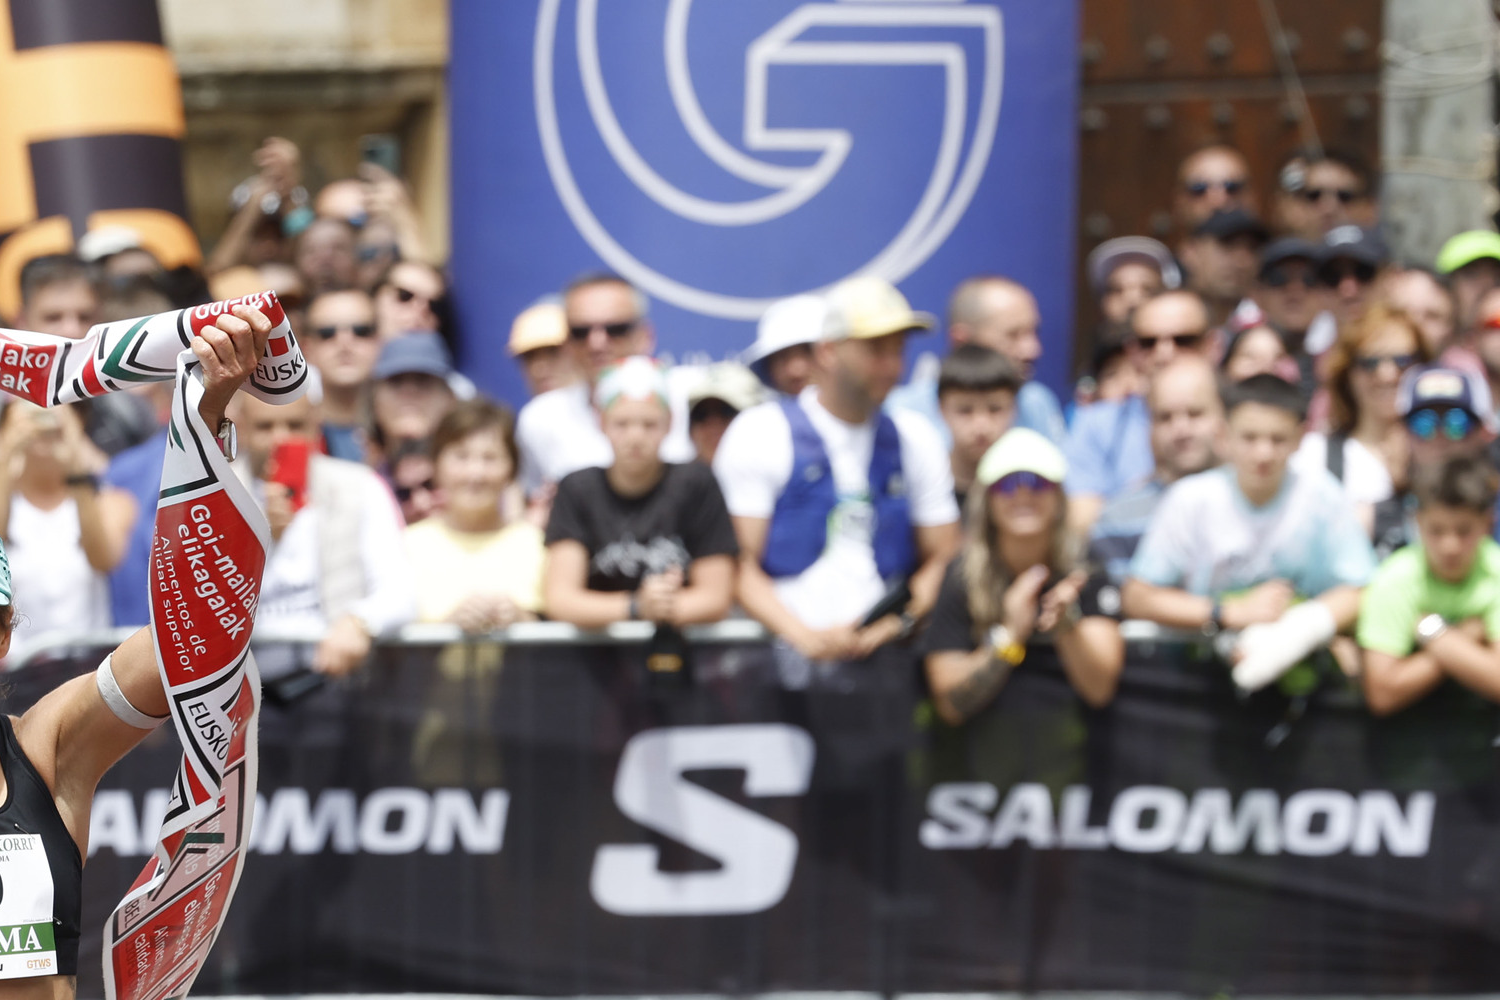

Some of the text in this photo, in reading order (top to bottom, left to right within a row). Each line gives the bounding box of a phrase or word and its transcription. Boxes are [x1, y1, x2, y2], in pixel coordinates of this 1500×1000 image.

[153, 525, 194, 673] calidad superior
[161, 536, 206, 656] Alimentos de
[178, 523, 246, 640] elikagaiak
[918, 781, 1436, 857] SALOMON
[27, 959, 51, 969] GTWS
